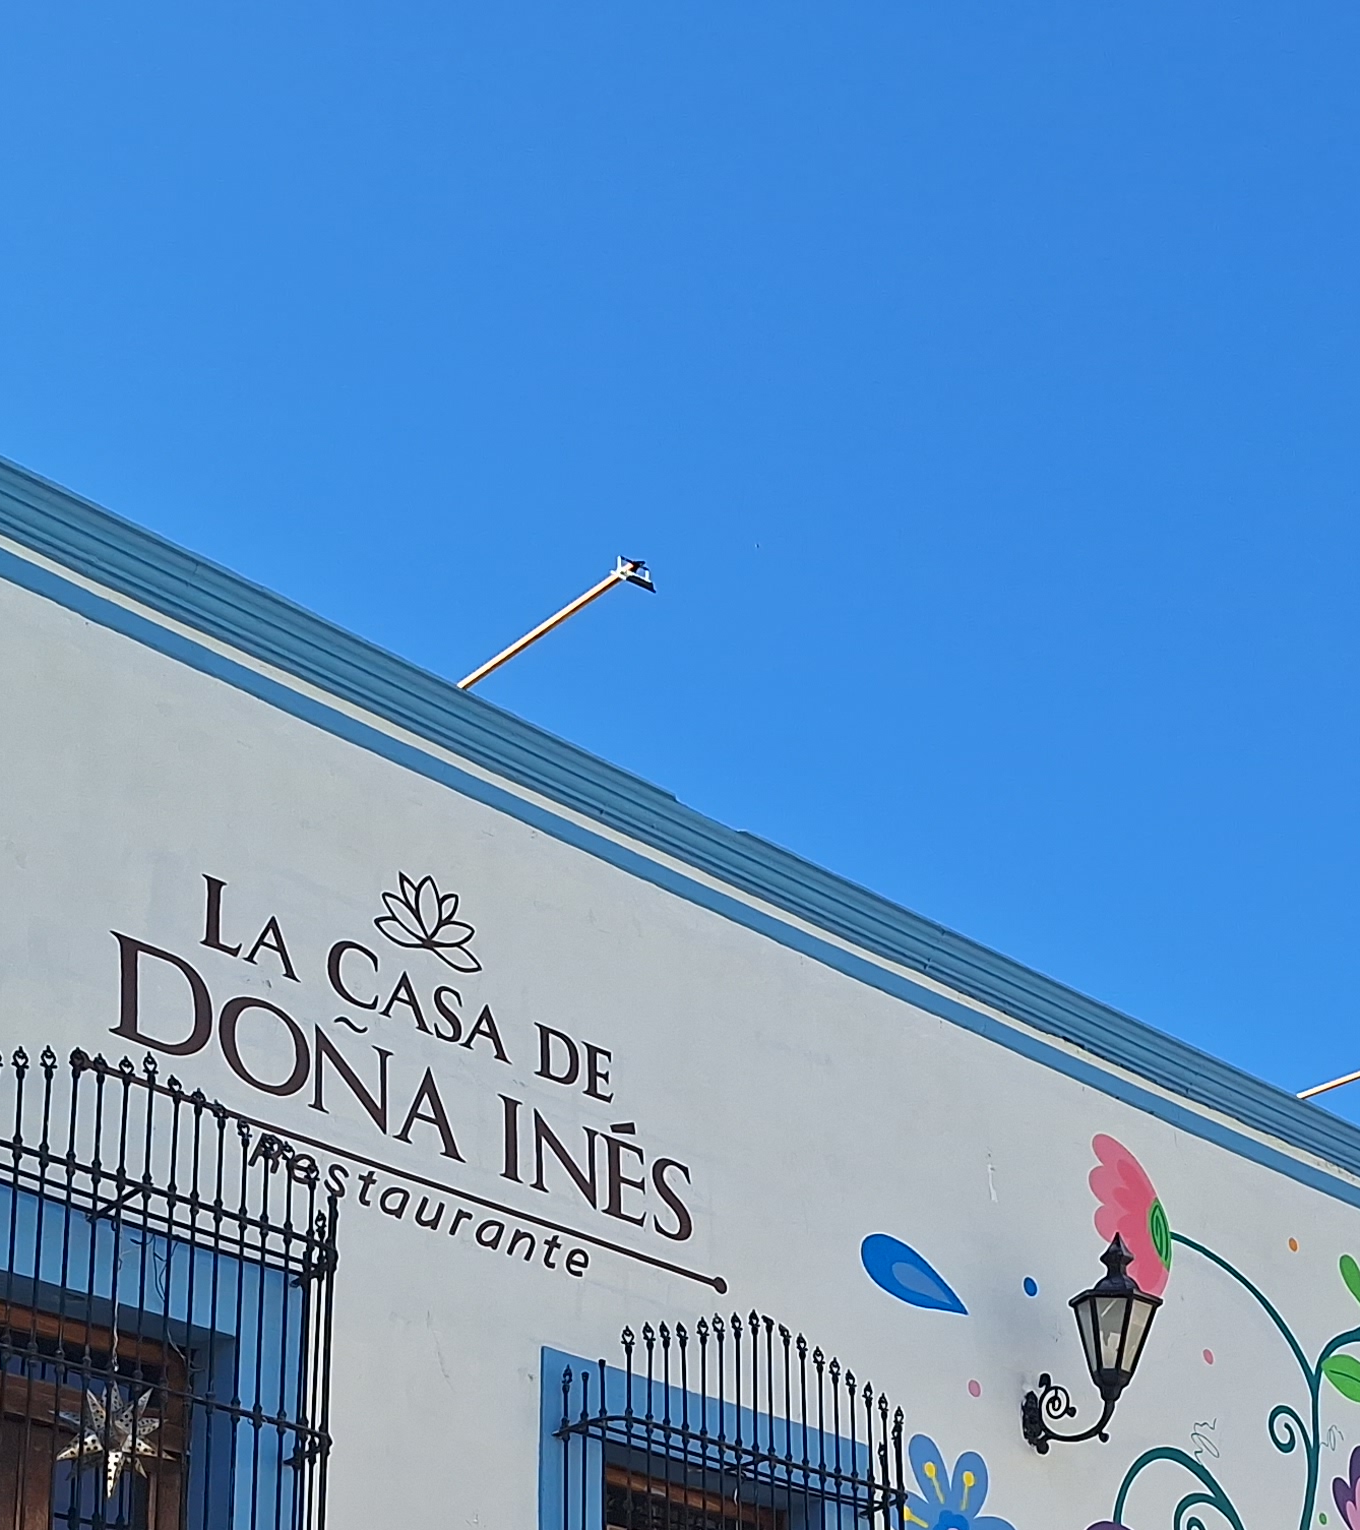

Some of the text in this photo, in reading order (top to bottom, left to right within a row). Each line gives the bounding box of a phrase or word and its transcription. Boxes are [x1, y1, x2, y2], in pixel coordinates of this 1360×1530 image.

[109, 930, 692, 1240] DOÑA INÉS
[200, 873, 614, 1102] LA CASA DE
[248, 1133, 588, 1277] Restaurante
